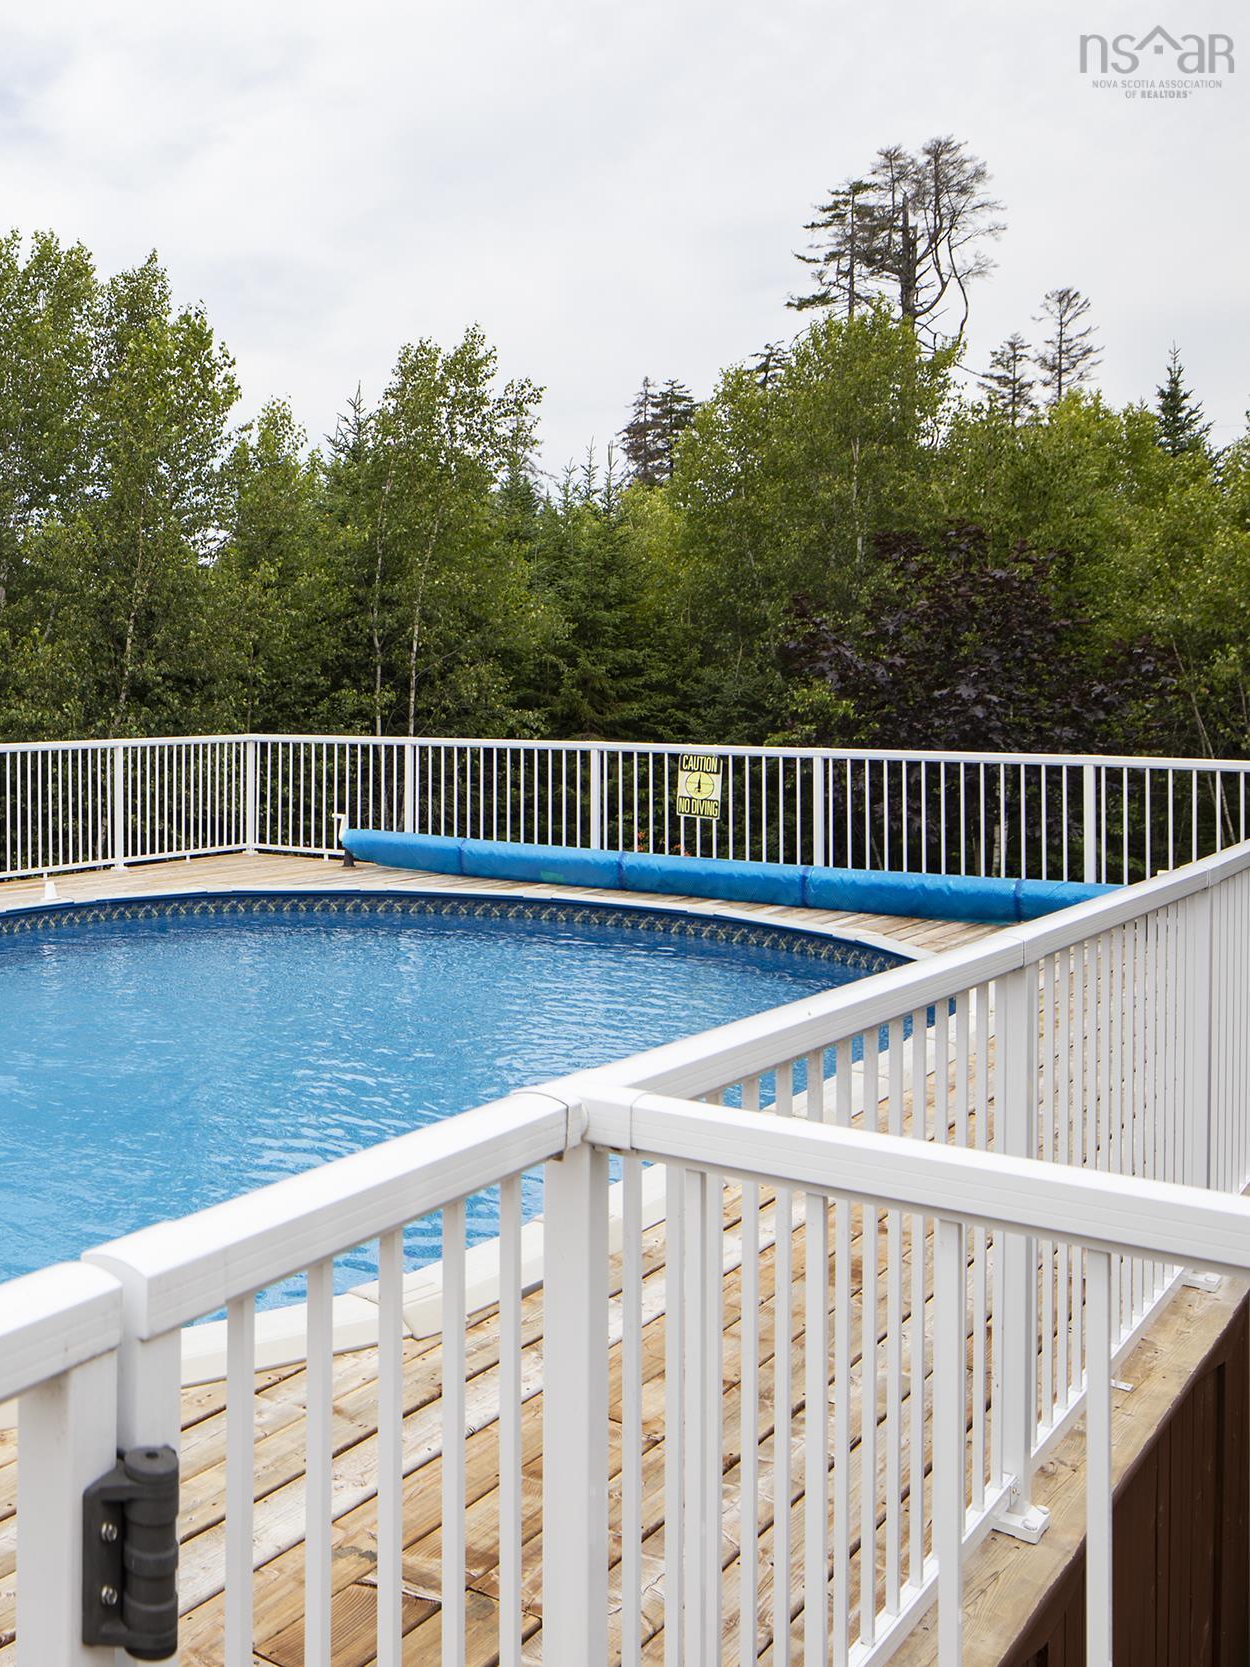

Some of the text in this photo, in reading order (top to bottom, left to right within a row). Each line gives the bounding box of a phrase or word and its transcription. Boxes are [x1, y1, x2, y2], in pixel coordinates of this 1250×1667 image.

[682, 755, 718, 772] CAUTION
[679, 797, 718, 816] NO DIVING
